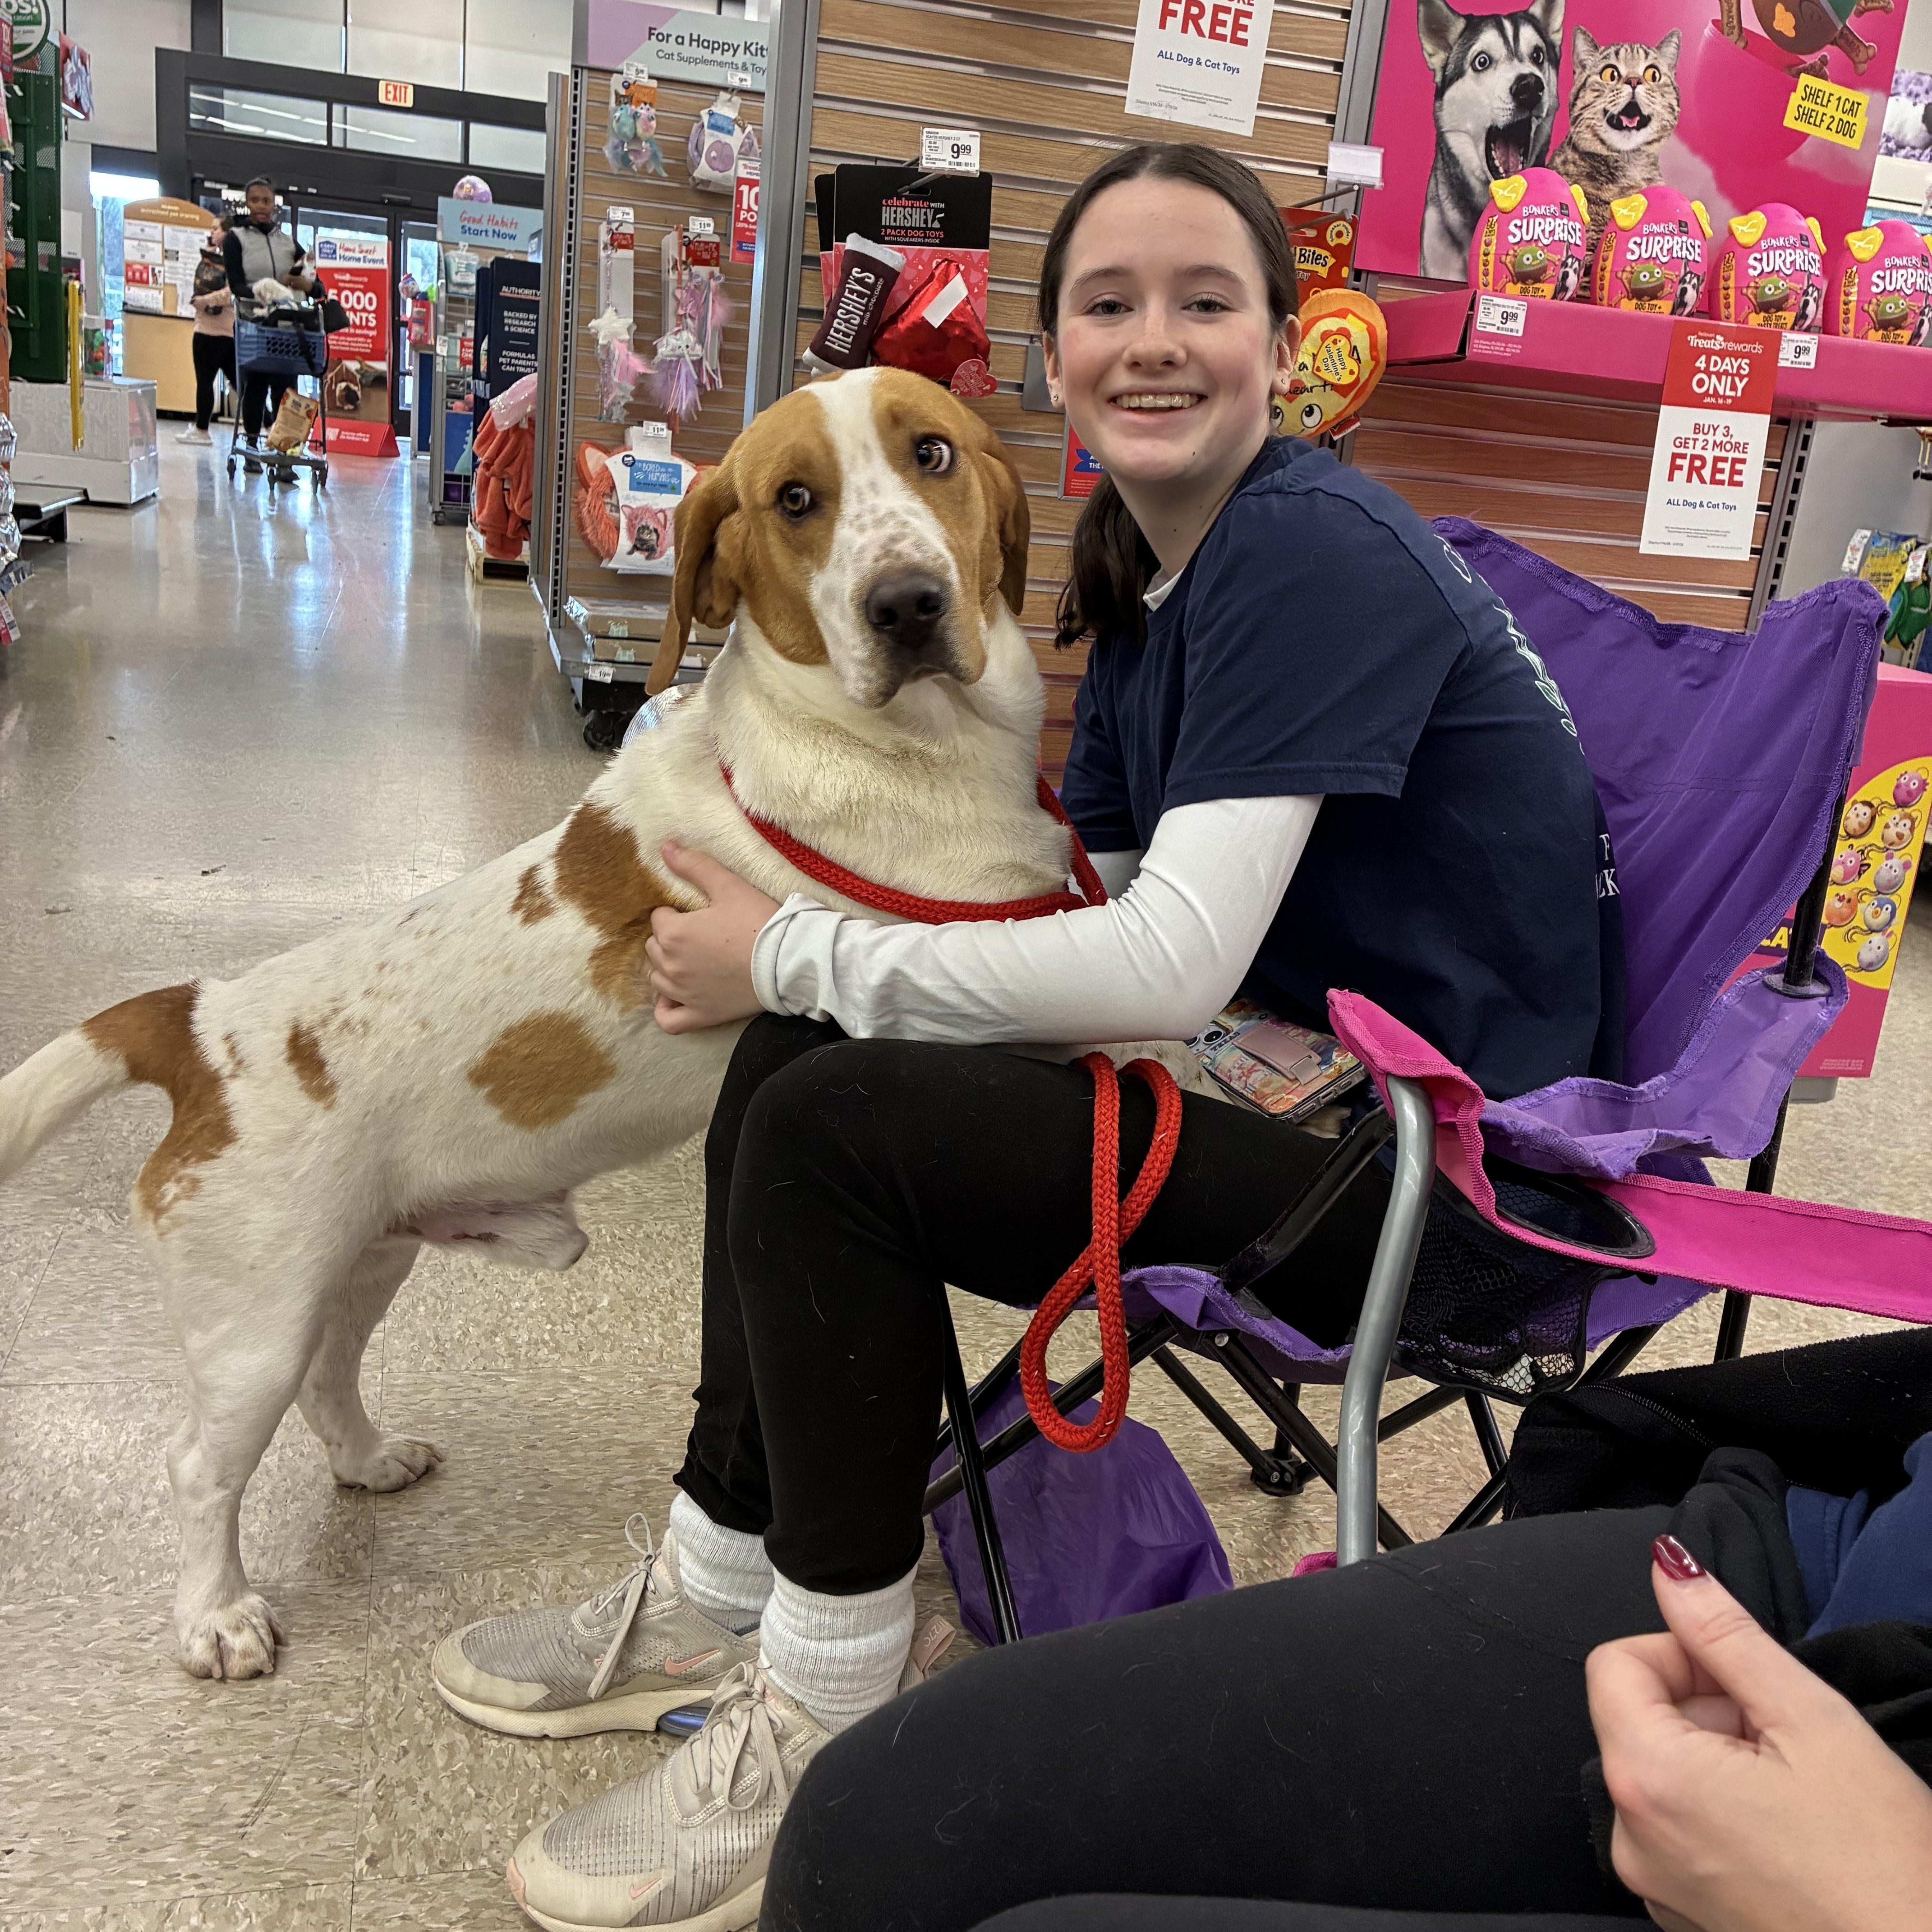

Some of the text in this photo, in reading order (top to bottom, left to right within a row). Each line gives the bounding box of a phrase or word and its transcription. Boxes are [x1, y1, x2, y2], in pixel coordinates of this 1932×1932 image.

[1159, 0, 1253, 47] FREE
[648, 26, 768, 58] For a Happy Kit
[656, 49, 675, 60] Cat
[676, 52, 739, 70] Supplements
[741, 62, 749, 71] &
[1157, 50, 1240, 74] ALL Dog & Cat Toys
[384, 83, 408, 104] EXIT
[1801, 84, 1862, 118] SHELF 1 CAT
[1794, 104, 1857, 139] SHELF 2 DOG
[882, 197, 929, 207] celebrate
[1523, 204, 1559, 217] BONKERS
[459, 210, 518, 230] Good Habits
[882, 206, 934, 228] HERSHEY
[460, 225, 517, 241] Start Now
[1643, 222, 1678, 235] BONKERS
[1761, 235, 1799, 250] BONKERS
[339, 253, 385, 265] Home Event
[1298, 248, 1329, 267] Bites
[1885, 255, 1921, 268] BONKERS
[501, 285, 541, 296] AUTHORITY
[869, 277, 884, 311] chocolate
[503, 310, 528, 320] BACKED
[825, 267, 875, 354] HERSHEY'S
[504, 318, 536, 327] RESEARCH
[510, 327, 535, 335] SCIENCE
[502, 350, 535, 359] FORMULAS
[511, 359, 538, 367] PARENTS
[1325, 344, 1342, 382] Valentine's
[1335, 348, 1347, 370] Happy
[1322, 358, 1333, 374] Day!
[1695, 354, 1750, 375] 4 DAYS
[1692, 373, 1749, 397] ONLY
[1693, 423, 1734, 440] BUY 3,
[1673, 437, 1749, 454] GET 2 MORE
[1667, 452, 1747, 488] FREE
[1666, 498, 1680, 506] ALL
[1683, 500, 1697, 509] Dog
[1722, 502, 1737, 512] Toys
